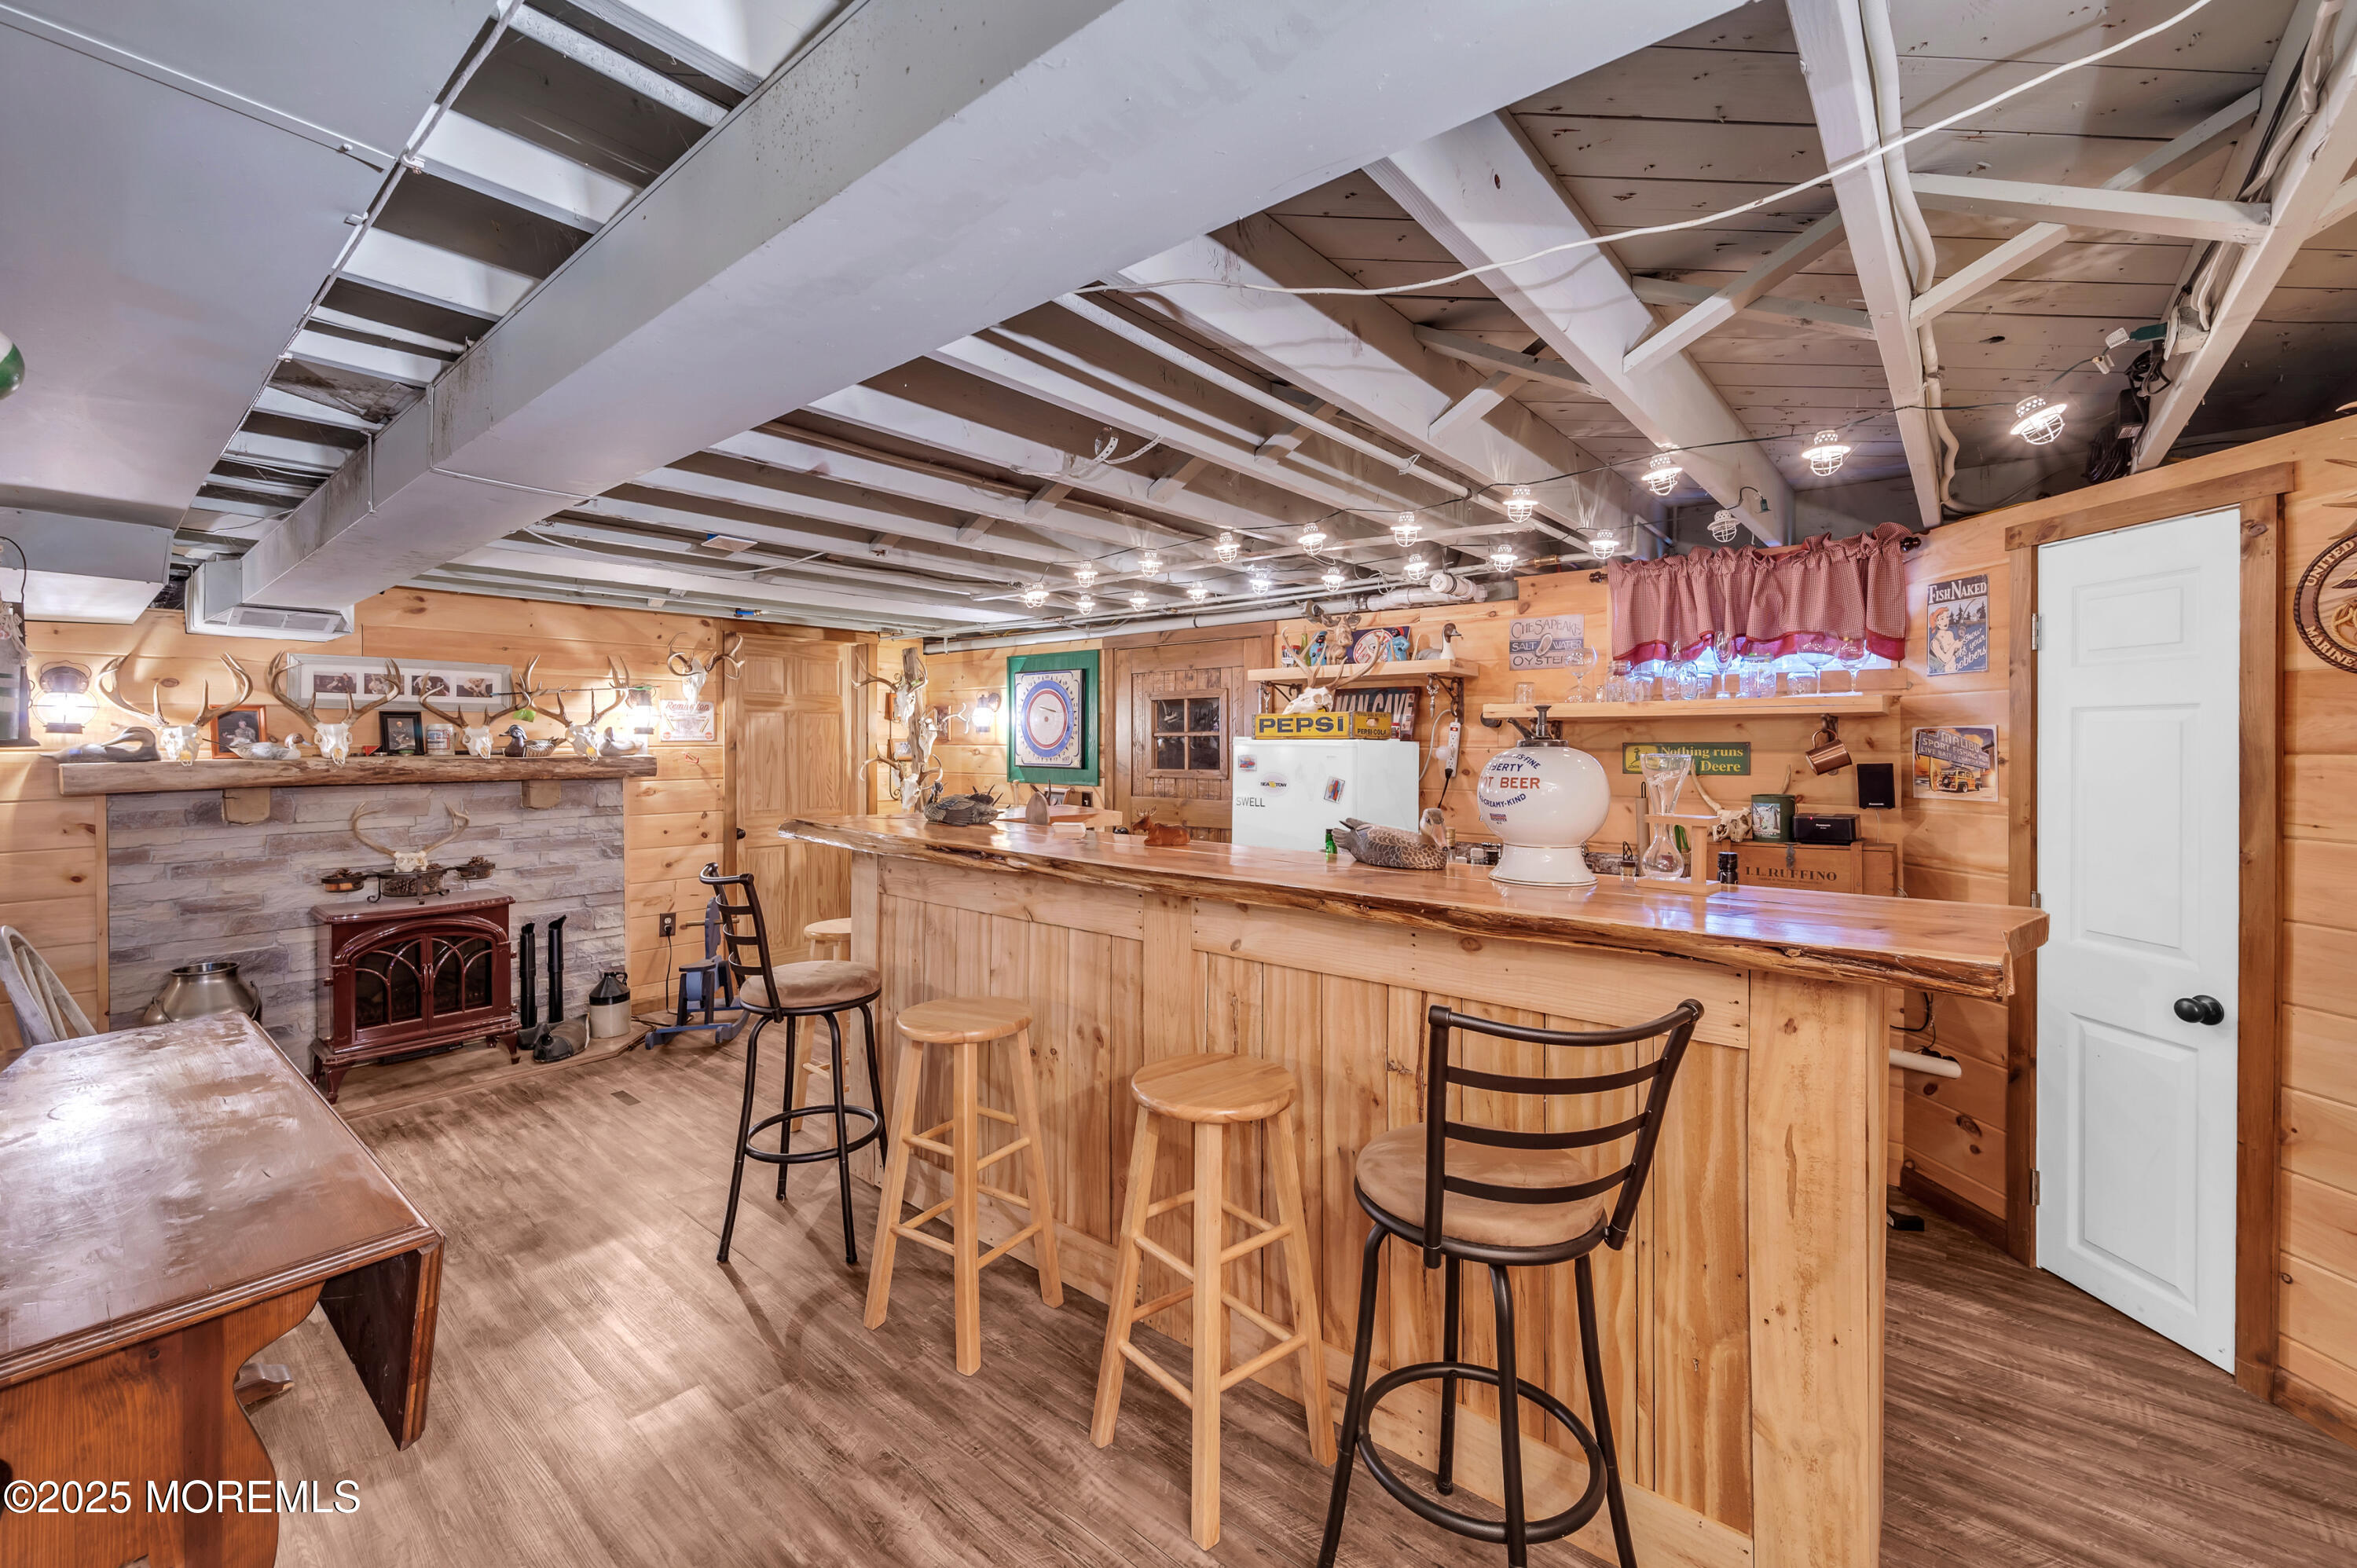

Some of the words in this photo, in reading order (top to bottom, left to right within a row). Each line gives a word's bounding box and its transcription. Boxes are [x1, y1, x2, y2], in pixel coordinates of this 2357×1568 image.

[2305, 540, 2355, 586] UNITED
[1512, 641, 1538, 652] SALT
[1552, 640, 1582, 650] WATER
[1969, 635, 1986, 653] your
[2305, 625, 2356, 667] MARINE
[1259, 716, 1343, 734] PEPSI
[1922, 738, 1950, 752] SPORT
[1952, 746, 1978, 759] FISHING
[1941, 732, 1980, 753] MALIBU
[1661, 746, 1710, 759] Nothing
[1713, 747, 1744, 757] runs
[1921, 746, 1936, 755] LIVE
[1700, 760, 1741, 772] Deere
[1499, 776, 1541, 789] BEER
[1236, 797, 1266, 808] SWELL
